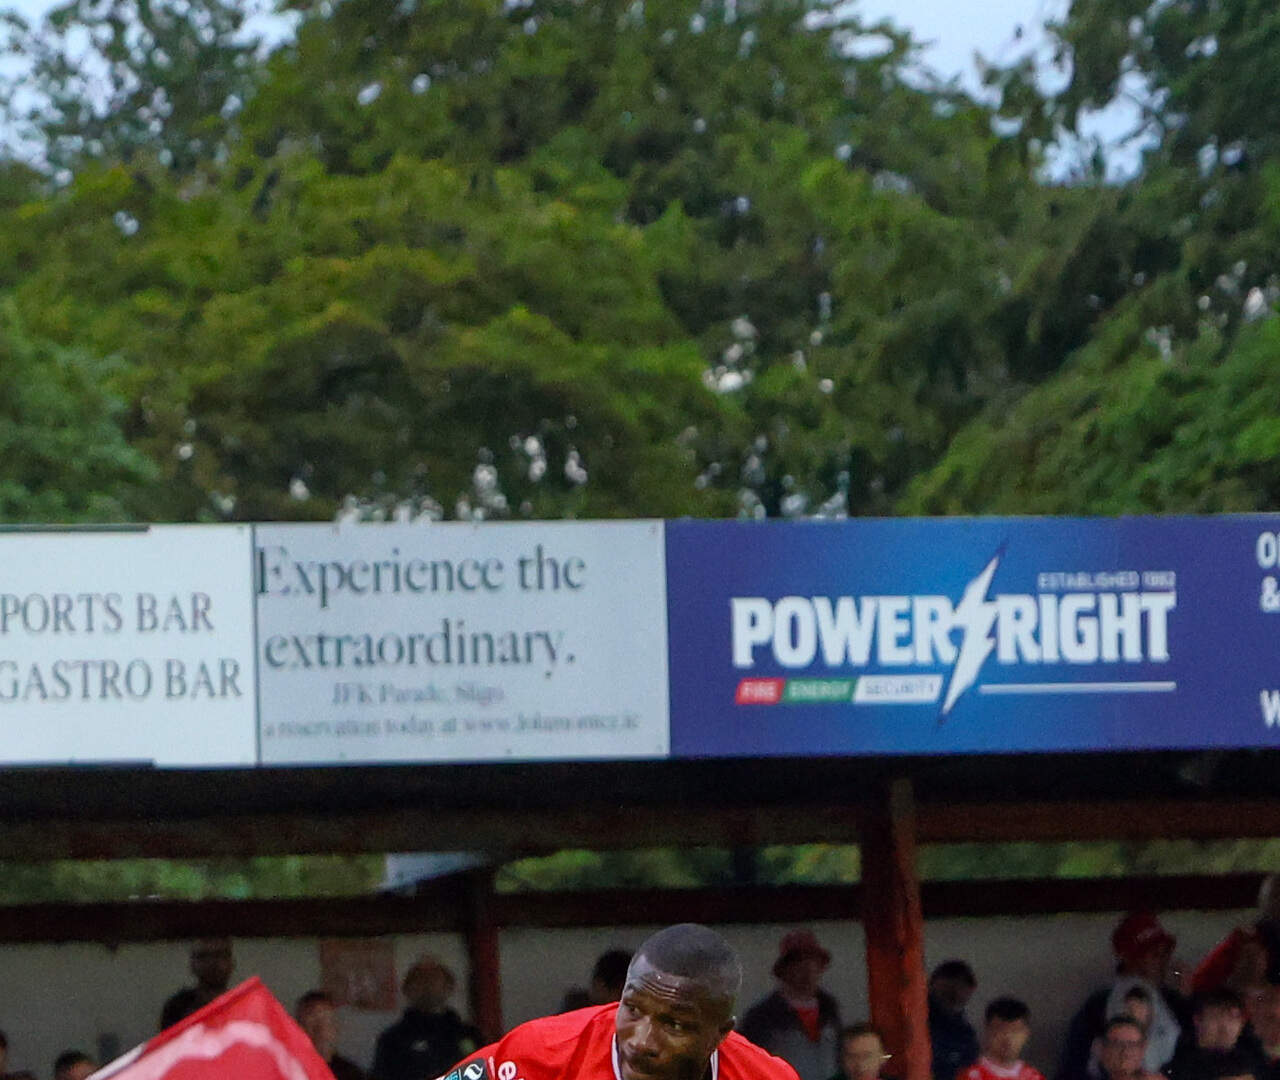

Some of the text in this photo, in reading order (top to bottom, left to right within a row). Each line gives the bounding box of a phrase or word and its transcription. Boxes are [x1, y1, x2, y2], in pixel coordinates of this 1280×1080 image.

[256, 544, 586, 608] Experience the
[136, 591, 215, 634] BAR
[731, 591, 1177, 667] POWER RIGHT
[164, 657, 244, 699] BAR
[264, 617, 576, 678] extraordinary.
